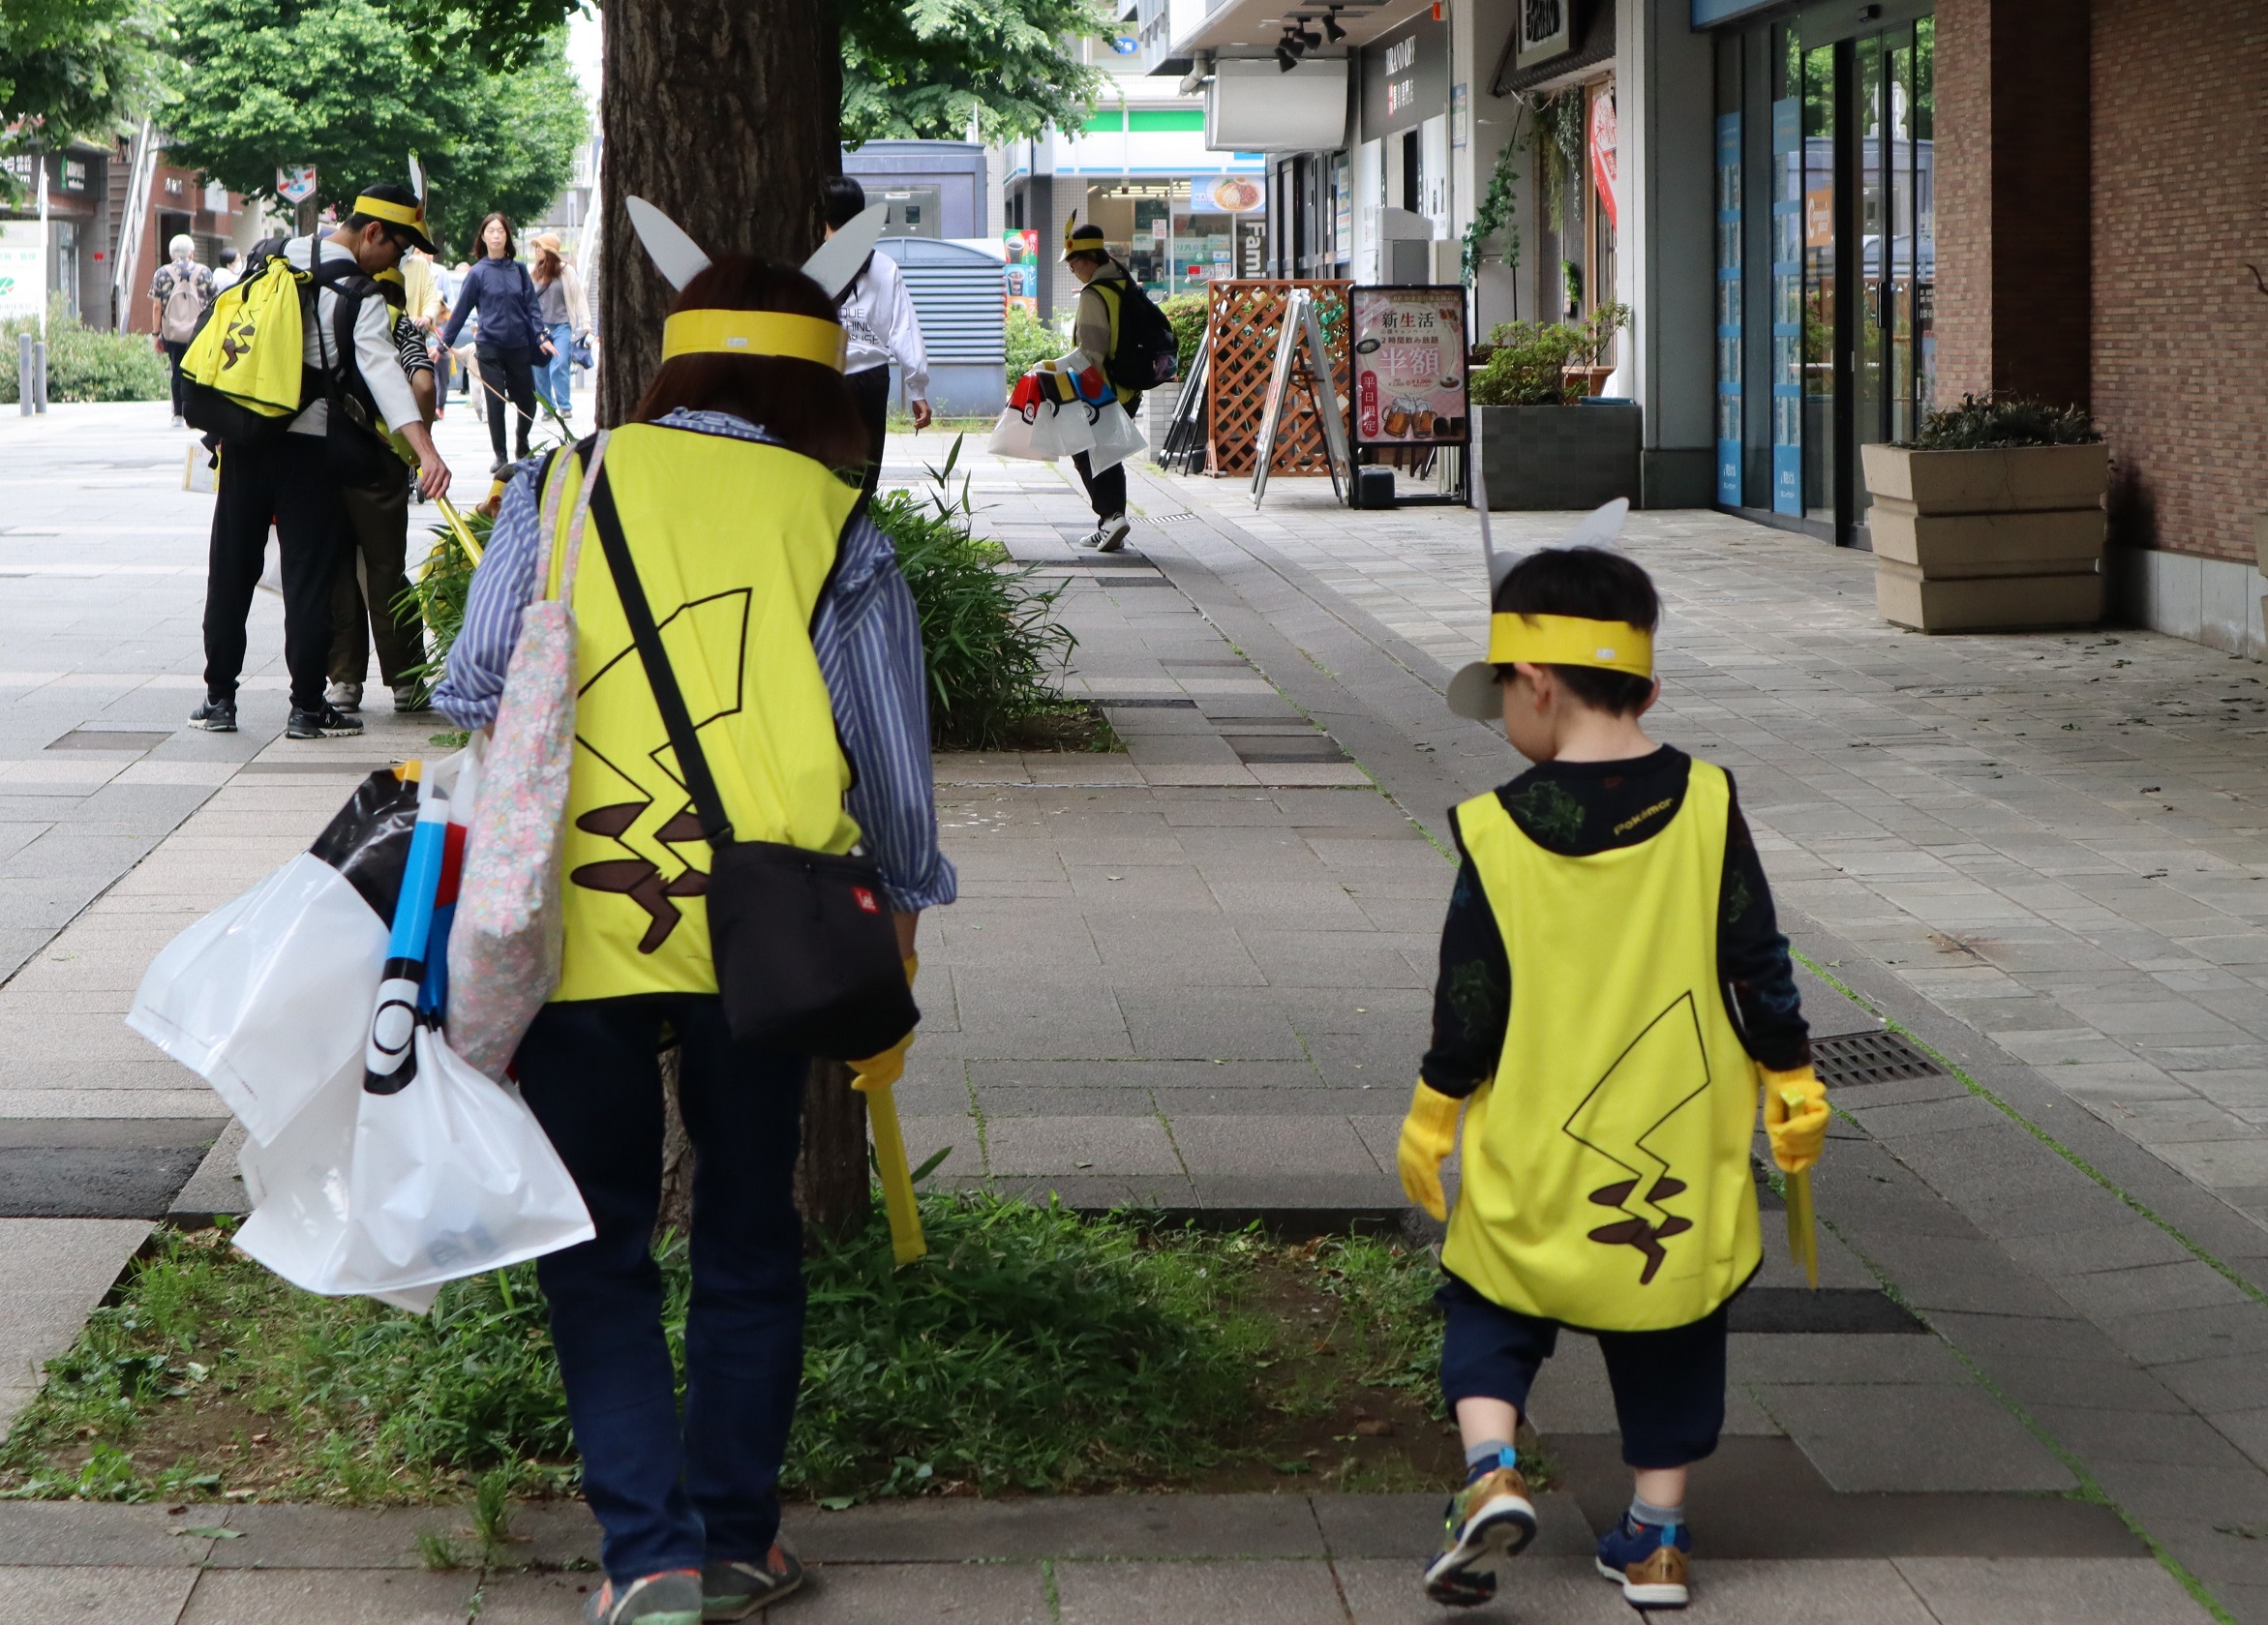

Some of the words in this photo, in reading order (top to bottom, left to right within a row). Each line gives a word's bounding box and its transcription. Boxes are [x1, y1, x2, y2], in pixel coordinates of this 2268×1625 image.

[1385, 42, 1405, 76] BRAND
[1404, 34, 1416, 68] OFF
[1246, 222, 1267, 278] Fami
[1381, 312, 1435, 329] 新生活
[1378, 346, 1440, 377] 半額
[1364, 376, 1376, 432] 平日限定
